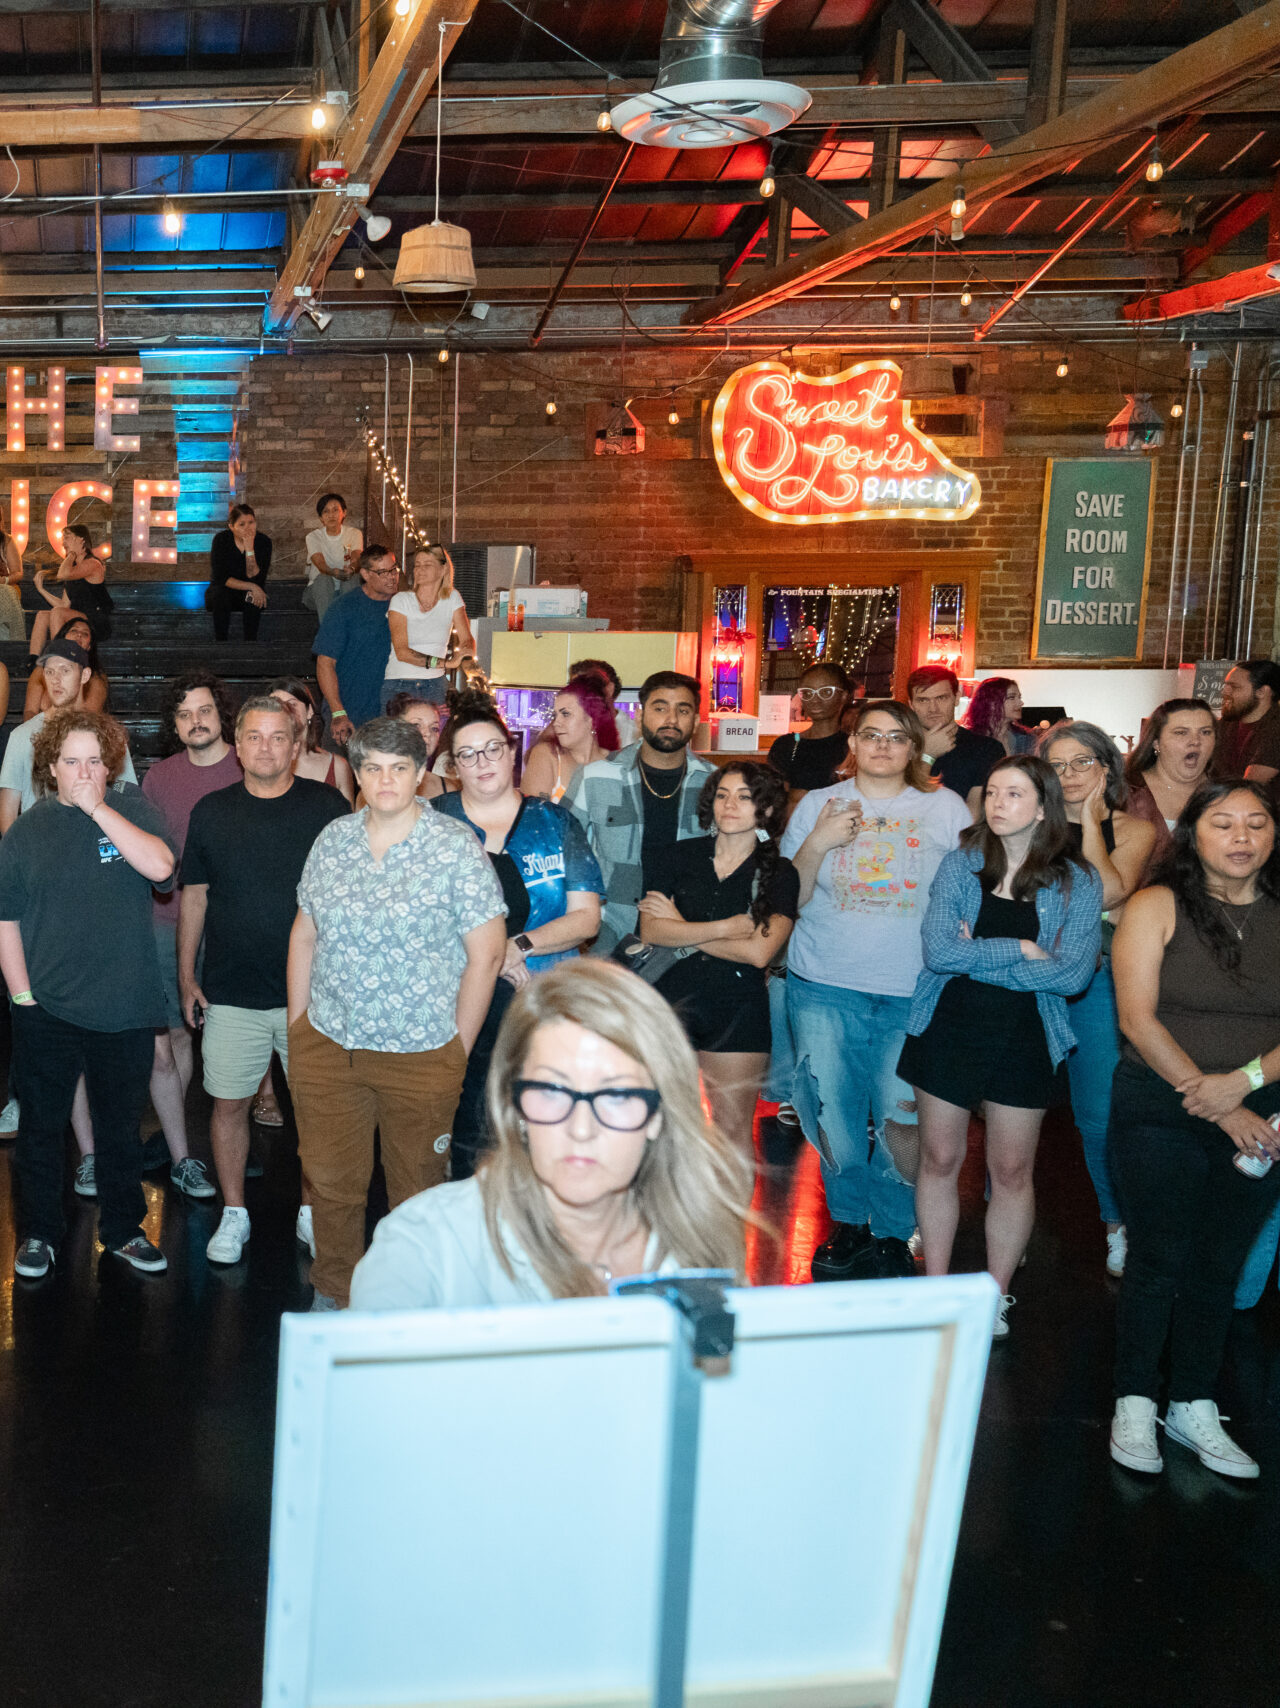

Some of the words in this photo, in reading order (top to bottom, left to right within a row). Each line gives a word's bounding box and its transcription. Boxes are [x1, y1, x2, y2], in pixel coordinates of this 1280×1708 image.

[736, 373, 897, 482] Sweet
[770, 434, 928, 507] Lou's
[862, 476, 970, 505] BAKERY
[1075, 491, 1125, 518] SAVE
[1065, 528, 1128, 553] ROOM
[1072, 566, 1114, 589] FOR
[1045, 599, 1138, 625] DESSERT.
[726, 727, 754, 736] BREAD
